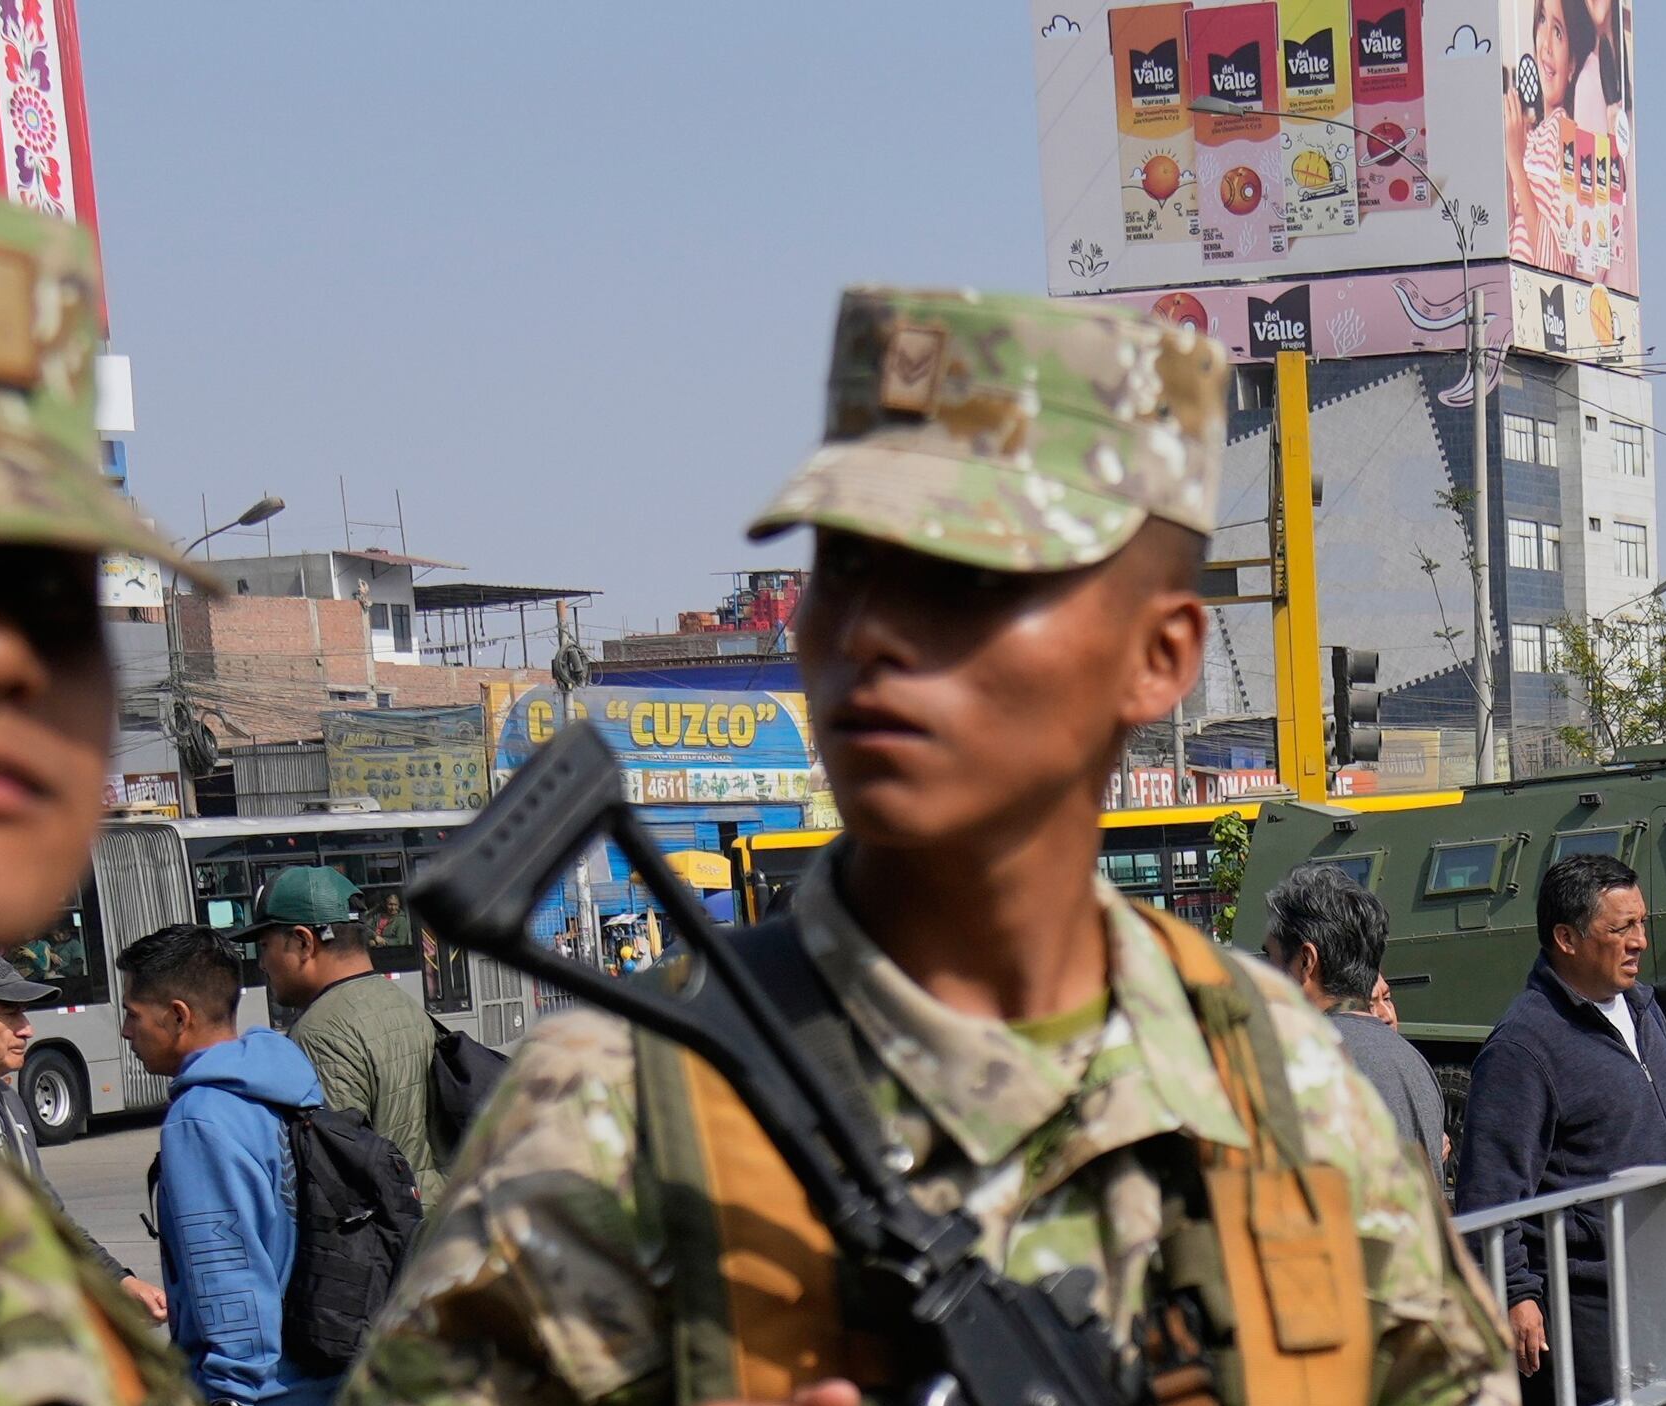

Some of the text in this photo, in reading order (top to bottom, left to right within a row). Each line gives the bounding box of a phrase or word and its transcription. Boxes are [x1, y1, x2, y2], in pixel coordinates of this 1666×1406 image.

[1370, 29, 1382, 38] del
[1361, 36, 1402, 54] Valle
[1297, 49, 1309, 59] del
[1142, 59, 1154, 69] del
[1222, 64, 1234, 74] del
[1288, 56, 1329, 75] Valle
[1134, 66, 1174, 85] Valle
[1213, 72, 1256, 91] Valle
[1298, 87, 1323, 97] Mango
[1141, 97, 1171, 107] Naranja
[1265, 310, 1280, 322] del
[1253, 320, 1305, 341] Valle
[1543, 313, 1565, 337] Valle
[1281, 341, 1306, 350] Frugos
[647, 774, 685, 799] 4611
